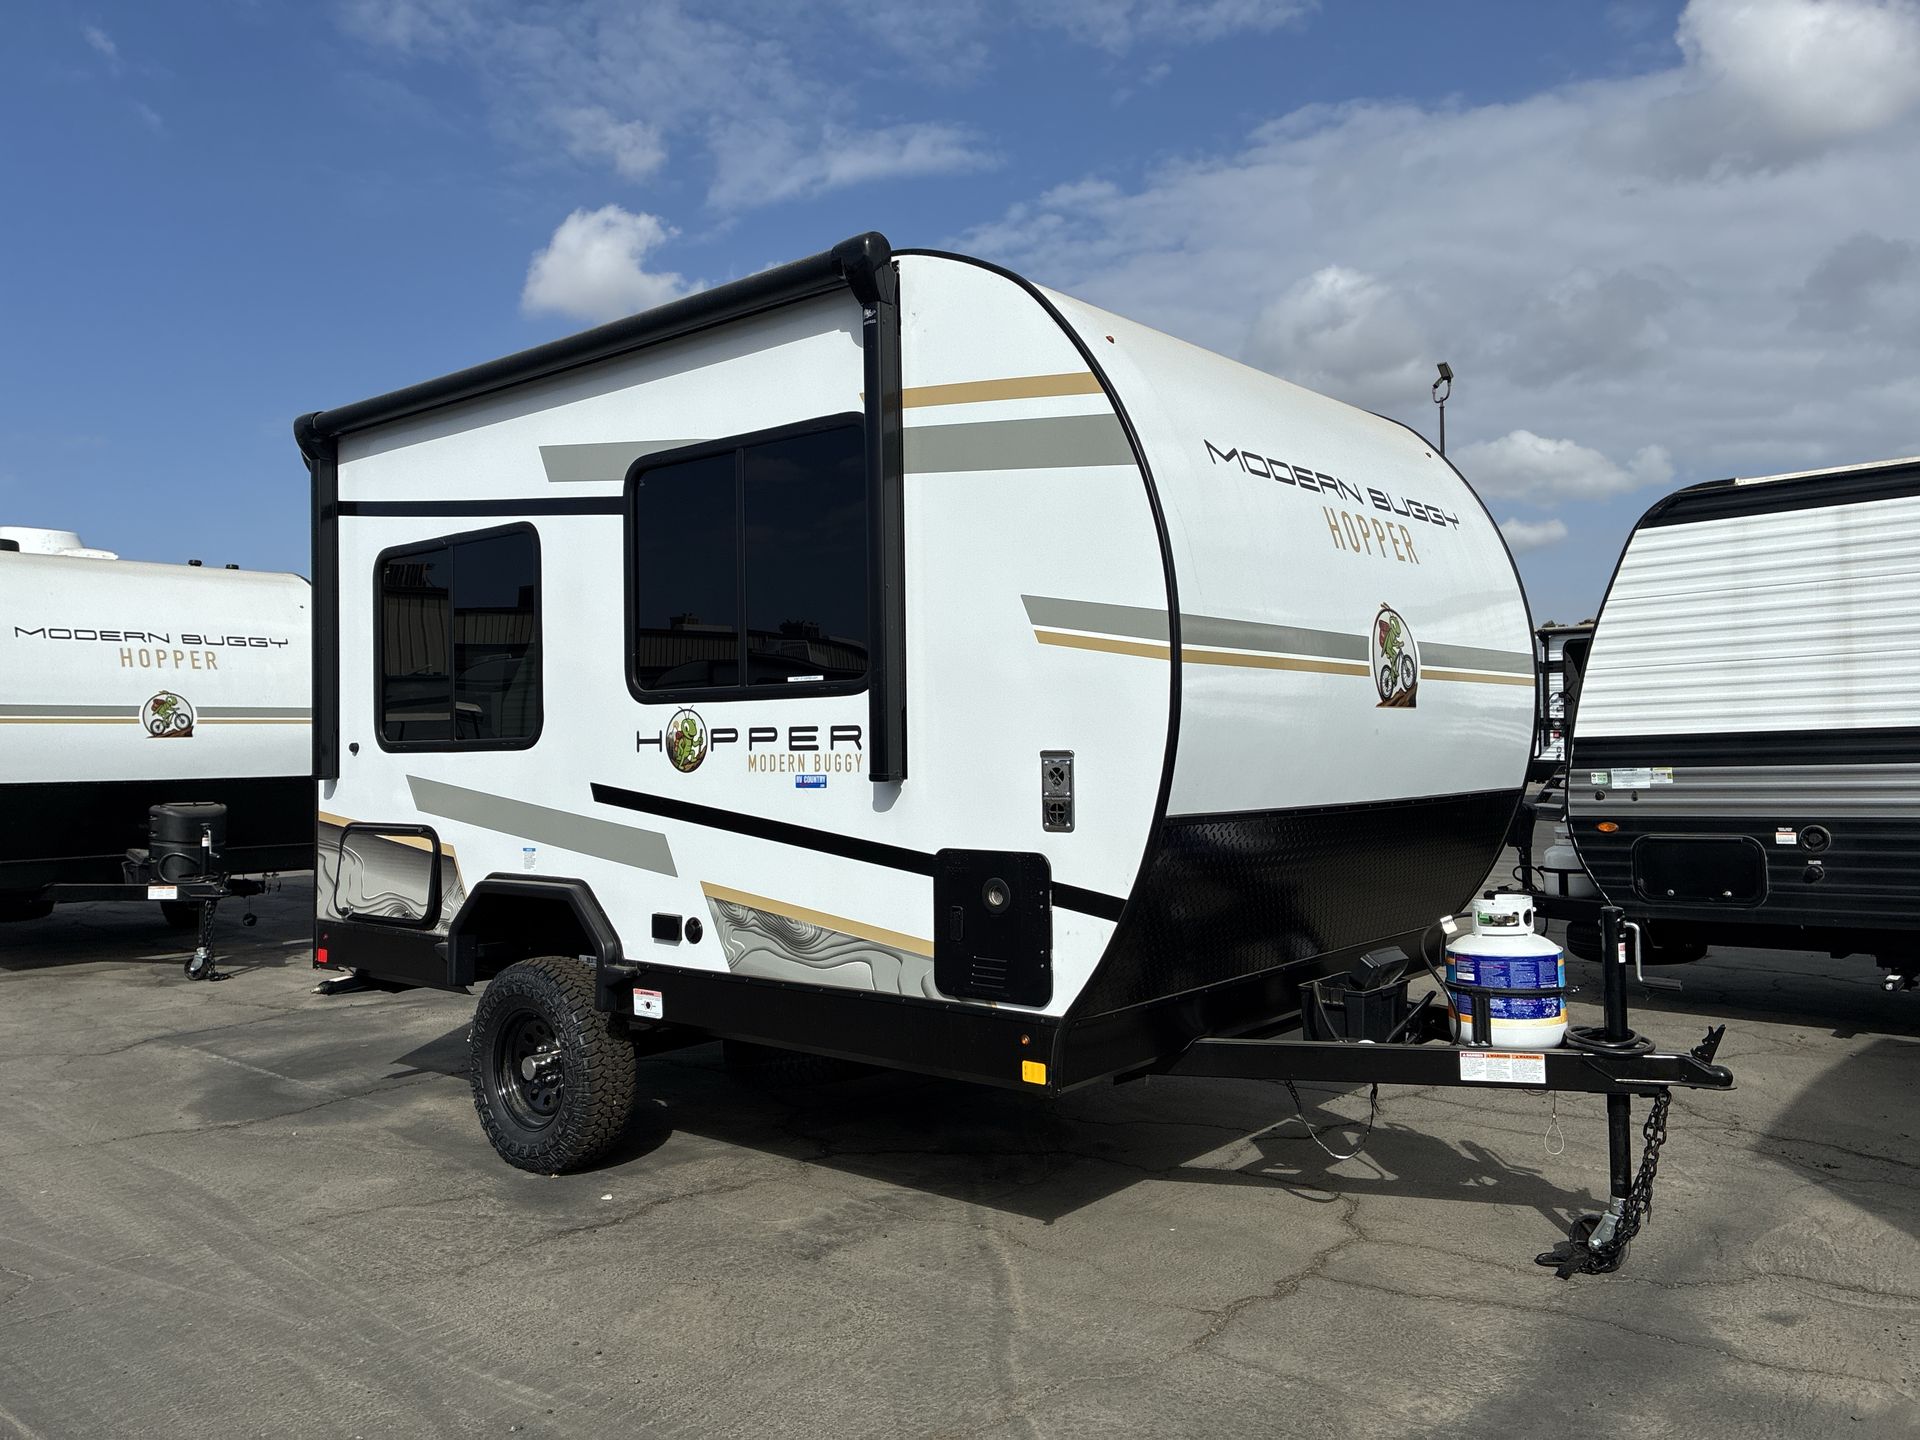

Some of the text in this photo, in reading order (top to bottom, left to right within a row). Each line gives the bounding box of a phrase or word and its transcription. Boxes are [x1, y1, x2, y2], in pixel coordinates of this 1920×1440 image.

[1203, 438, 1460, 531] MODERN BUGGY
[1322, 505, 1420, 565] HOPPER
[14, 626, 289, 649] MODERN BUGGY
[119, 647, 219, 671] HOPPER
[748, 753, 863, 773] MODERN BUGGY
[803, 775, 826, 784] COUNTRY
